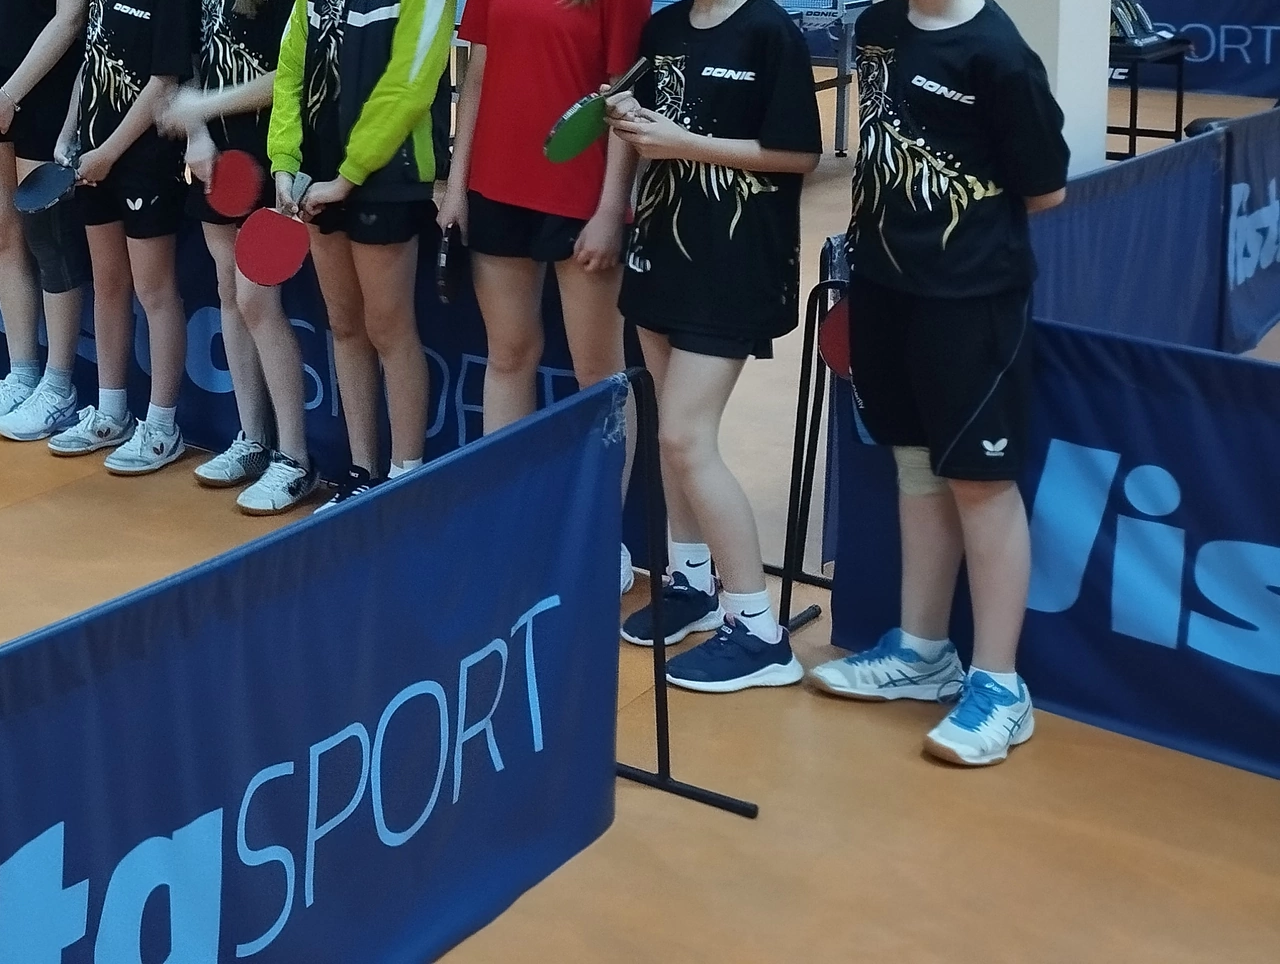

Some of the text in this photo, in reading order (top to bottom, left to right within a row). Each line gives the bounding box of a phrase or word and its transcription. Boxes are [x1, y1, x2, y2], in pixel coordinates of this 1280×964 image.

[113, 2, 152, 20] DONIC
[805, 10, 839, 18] DONIC
[700, 65, 756, 82] DONIC
[910, 74, 976, 105] DONIC
